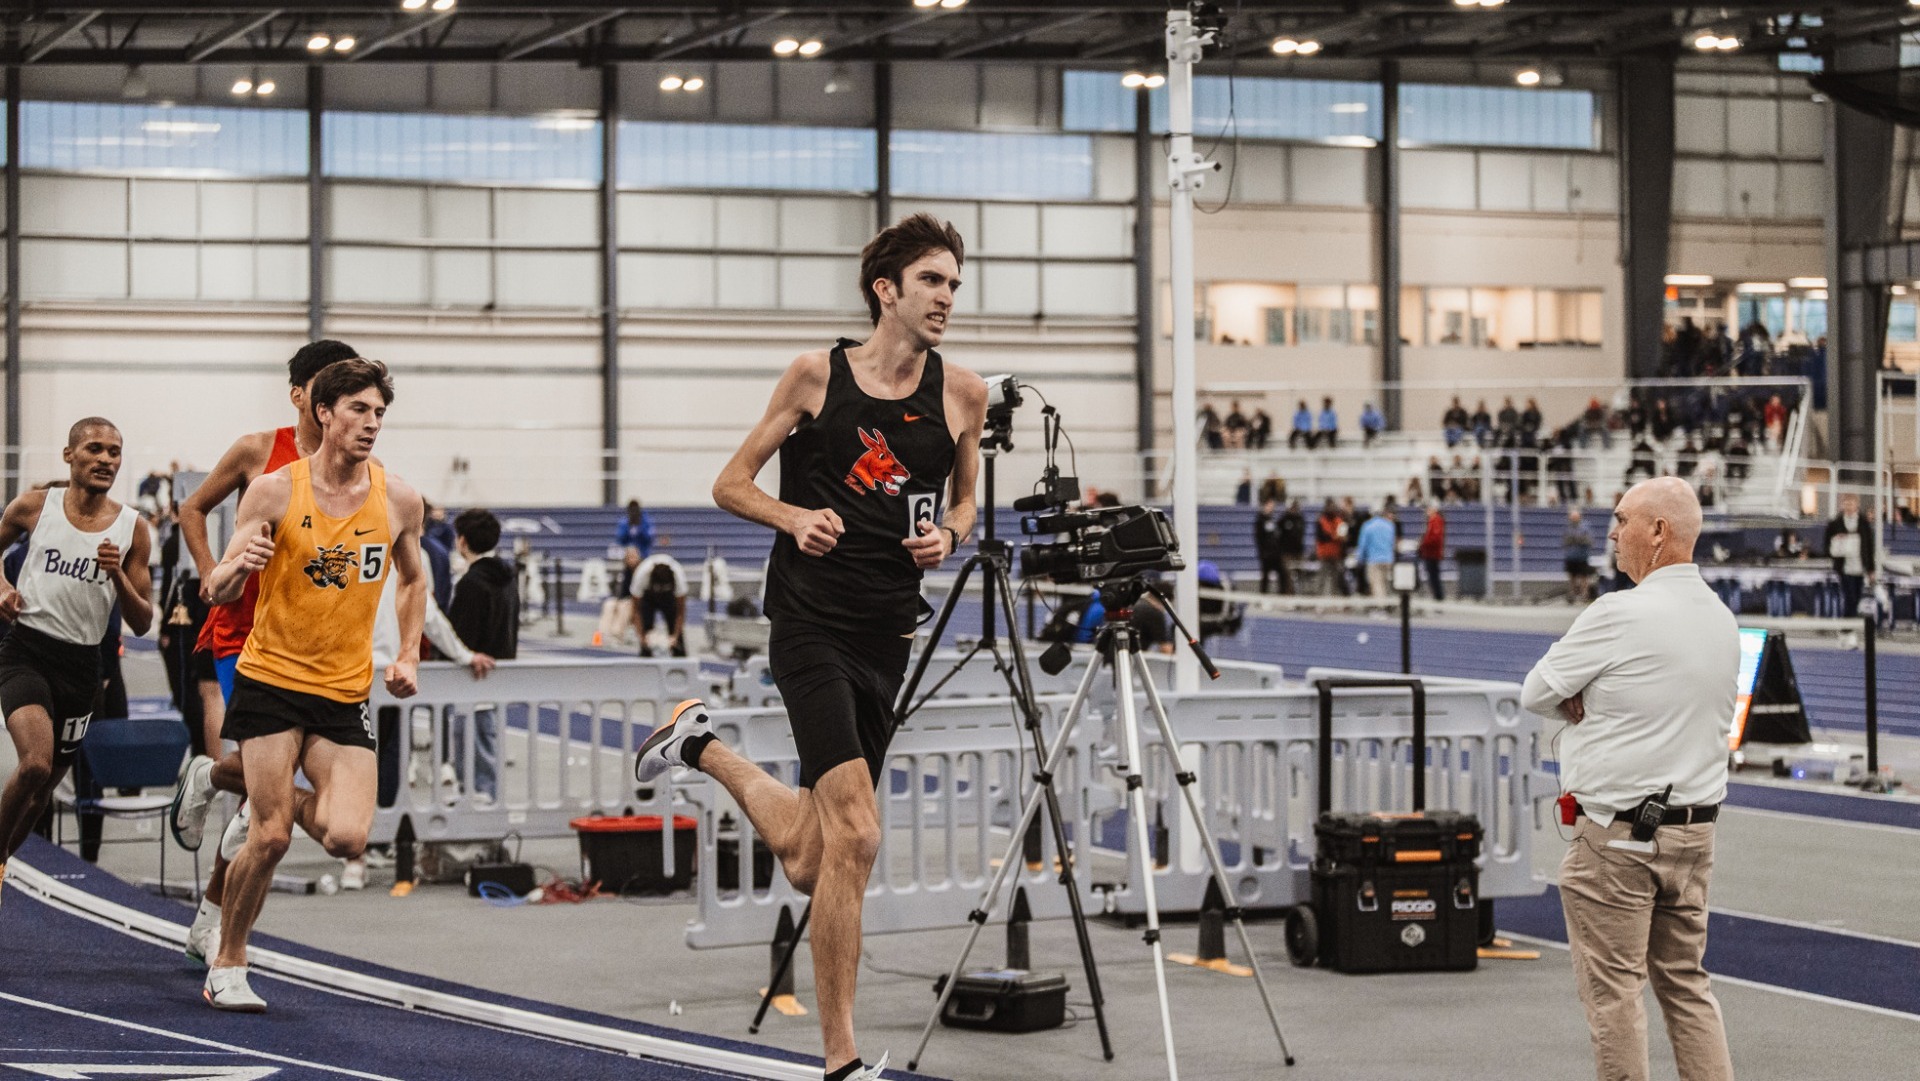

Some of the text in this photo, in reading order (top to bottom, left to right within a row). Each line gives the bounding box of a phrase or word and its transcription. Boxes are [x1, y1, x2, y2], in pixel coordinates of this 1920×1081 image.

[301, 515, 312, 528] A
[914, 497, 932, 537] 6
[45, 549, 104, 585] Butl
[363, 546, 382, 579] 5
[67, 716, 88, 740] 11
[1391, 900, 1437, 913] RIDGID
